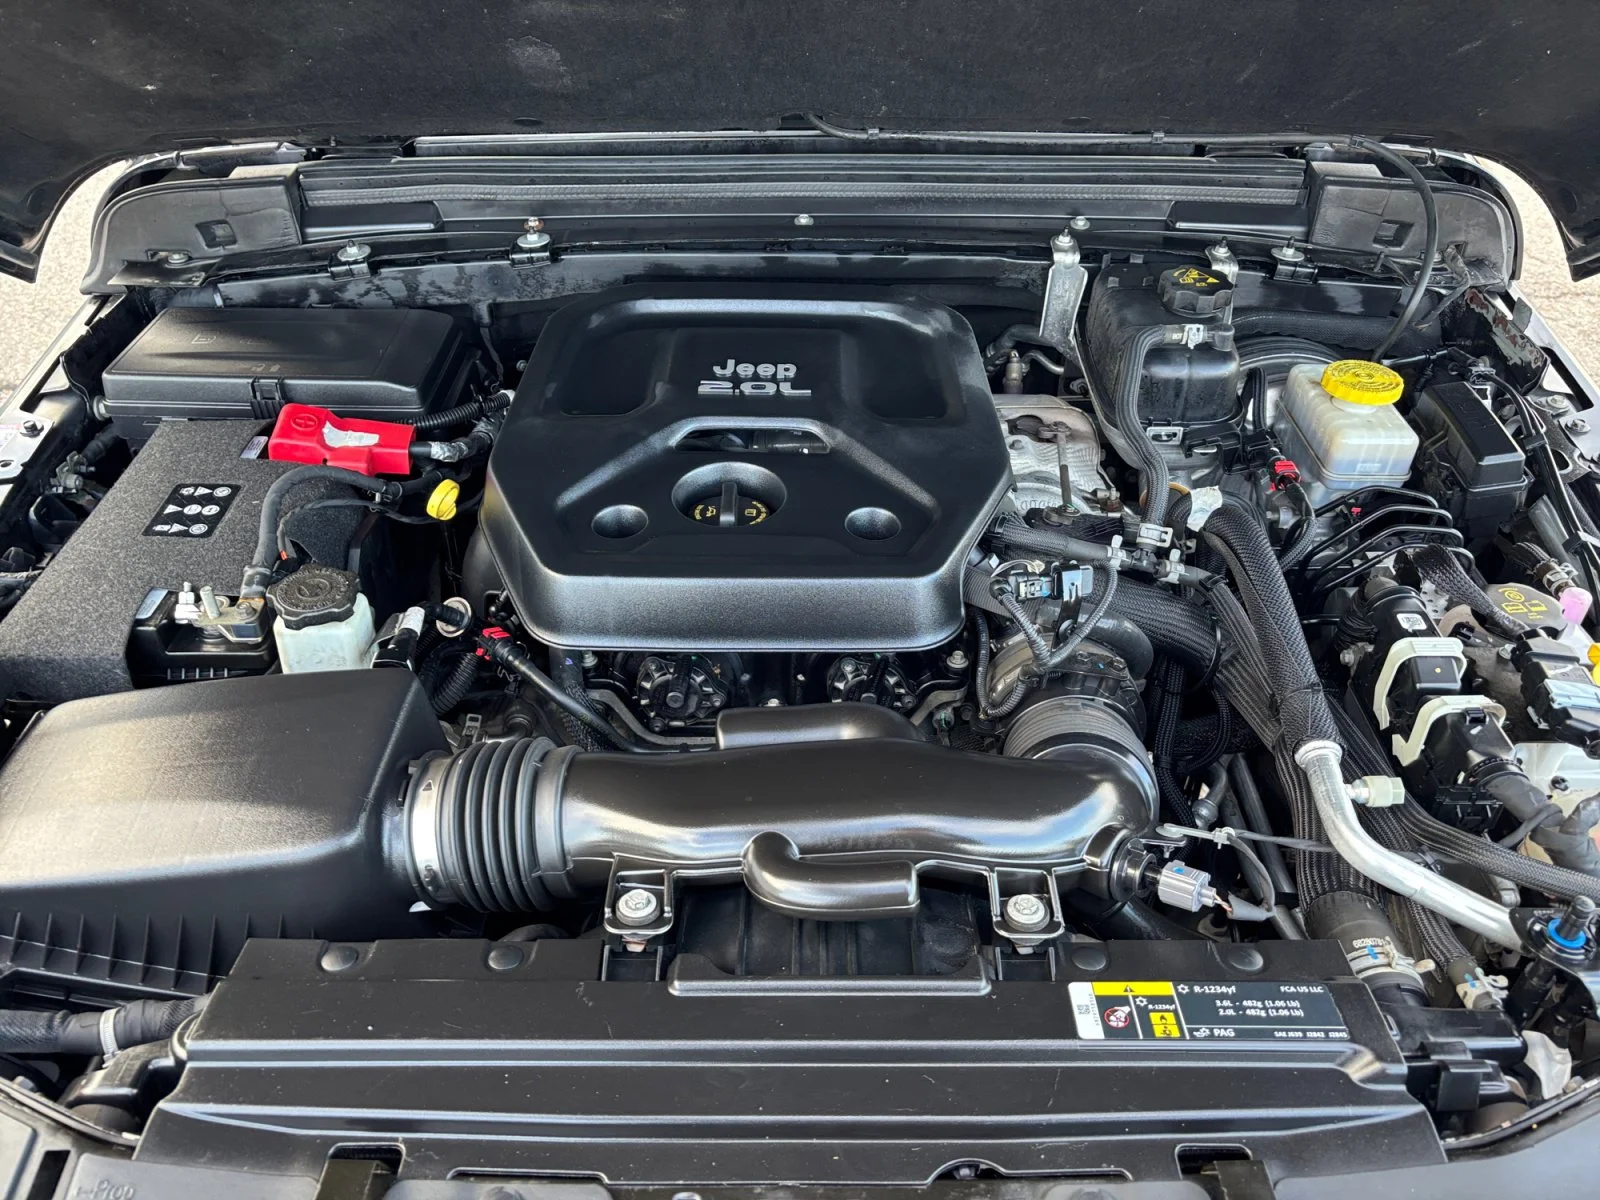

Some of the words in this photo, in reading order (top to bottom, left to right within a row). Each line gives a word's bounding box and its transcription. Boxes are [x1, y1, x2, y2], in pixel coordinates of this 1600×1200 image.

[713, 359, 797, 380] Jeep
[698, 380, 812, 397] 2.0L
[1193, 985, 1237, 995] R-1234yf
[1215, 999, 1234, 1007] 3.6L
[1242, 1000, 1263, 1008] 482g
[1264, 1000, 1287, 1008] (1.06
[1218, 1008, 1237, 1016] 2.0L
[1245, 1008, 1267, 1017] 482g
[1268, 1009, 1291, 1017] (1.06
[1213, 1028, 1236, 1037] PAG
